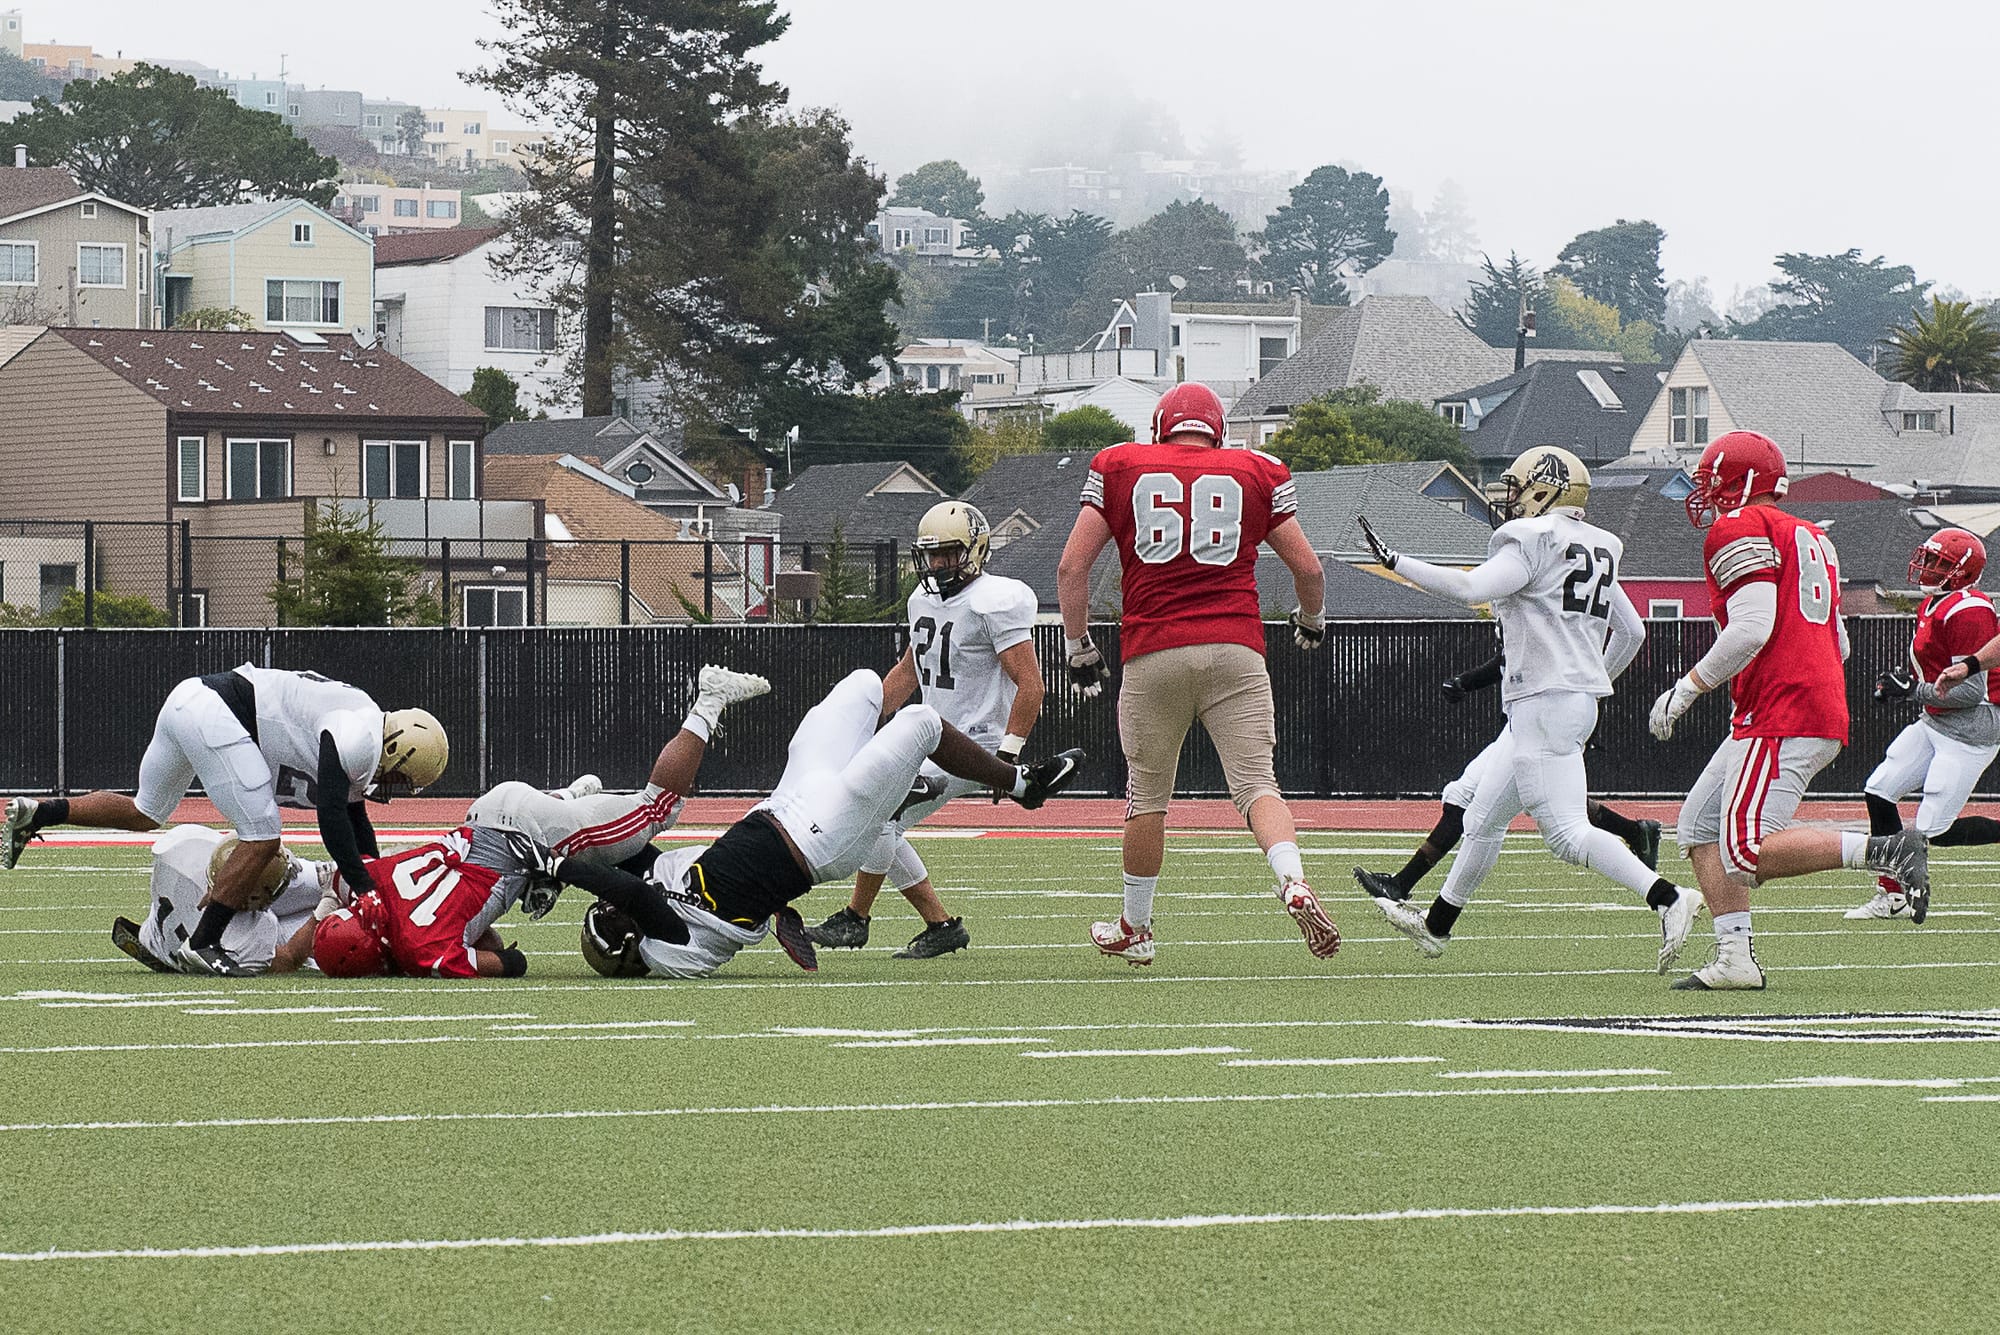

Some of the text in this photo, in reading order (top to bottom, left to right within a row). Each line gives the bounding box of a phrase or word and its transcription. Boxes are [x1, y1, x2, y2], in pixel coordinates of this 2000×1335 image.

[1132, 472, 1243, 566] 68
[1563, 542, 1614, 619] 22
[914, 616, 955, 691] 21
[391, 849, 463, 927] 10
